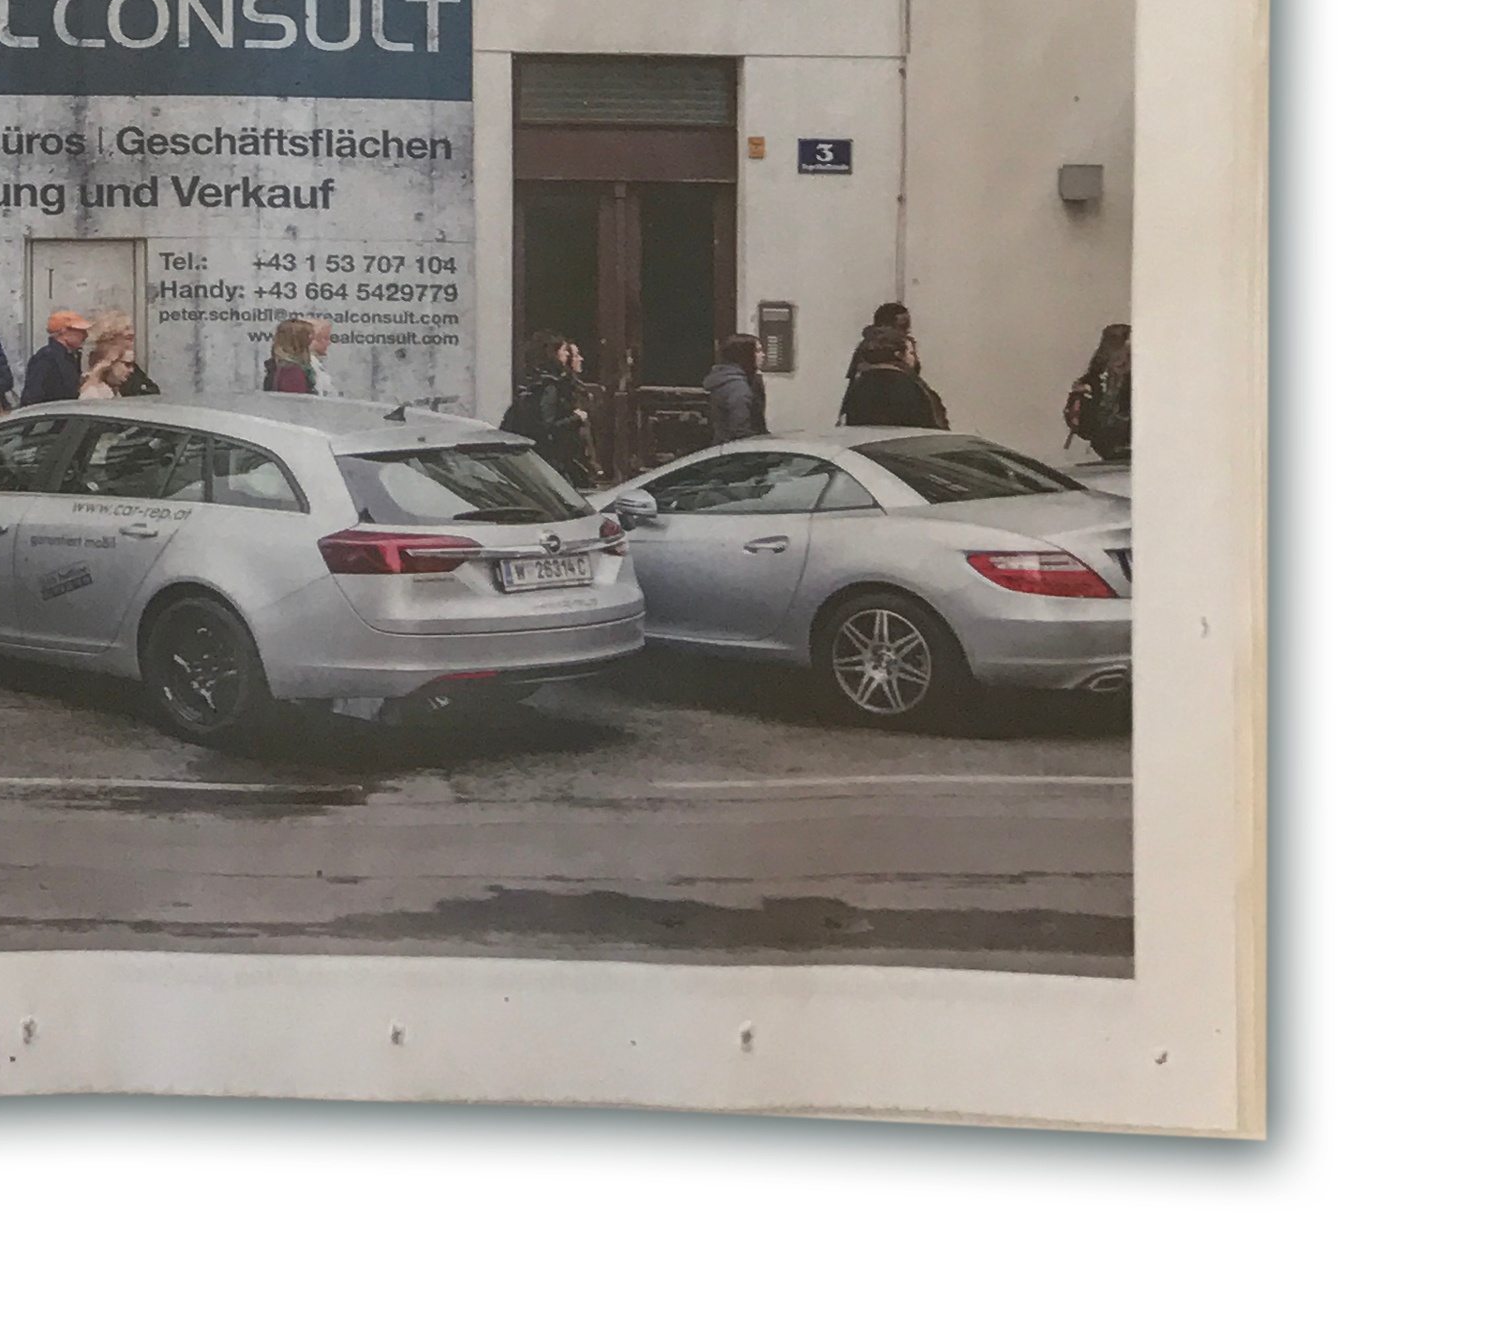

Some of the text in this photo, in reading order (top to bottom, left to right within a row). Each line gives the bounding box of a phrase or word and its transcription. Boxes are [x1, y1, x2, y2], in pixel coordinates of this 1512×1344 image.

[116, 126, 452, 160] Geschäftsflächen
[816, 143, 834, 162] 3
[79, 176, 159, 209] und
[170, 176, 335, 210] Verkauf
[253, 254, 296, 272] +43
[305, 256, 316, 271] 1
[325, 255, 355, 273] 53
[363, 255, 406, 274] 707
[415, 256, 457, 274] 104
[160, 280, 458, 302] Handy: +43 664 5429779
